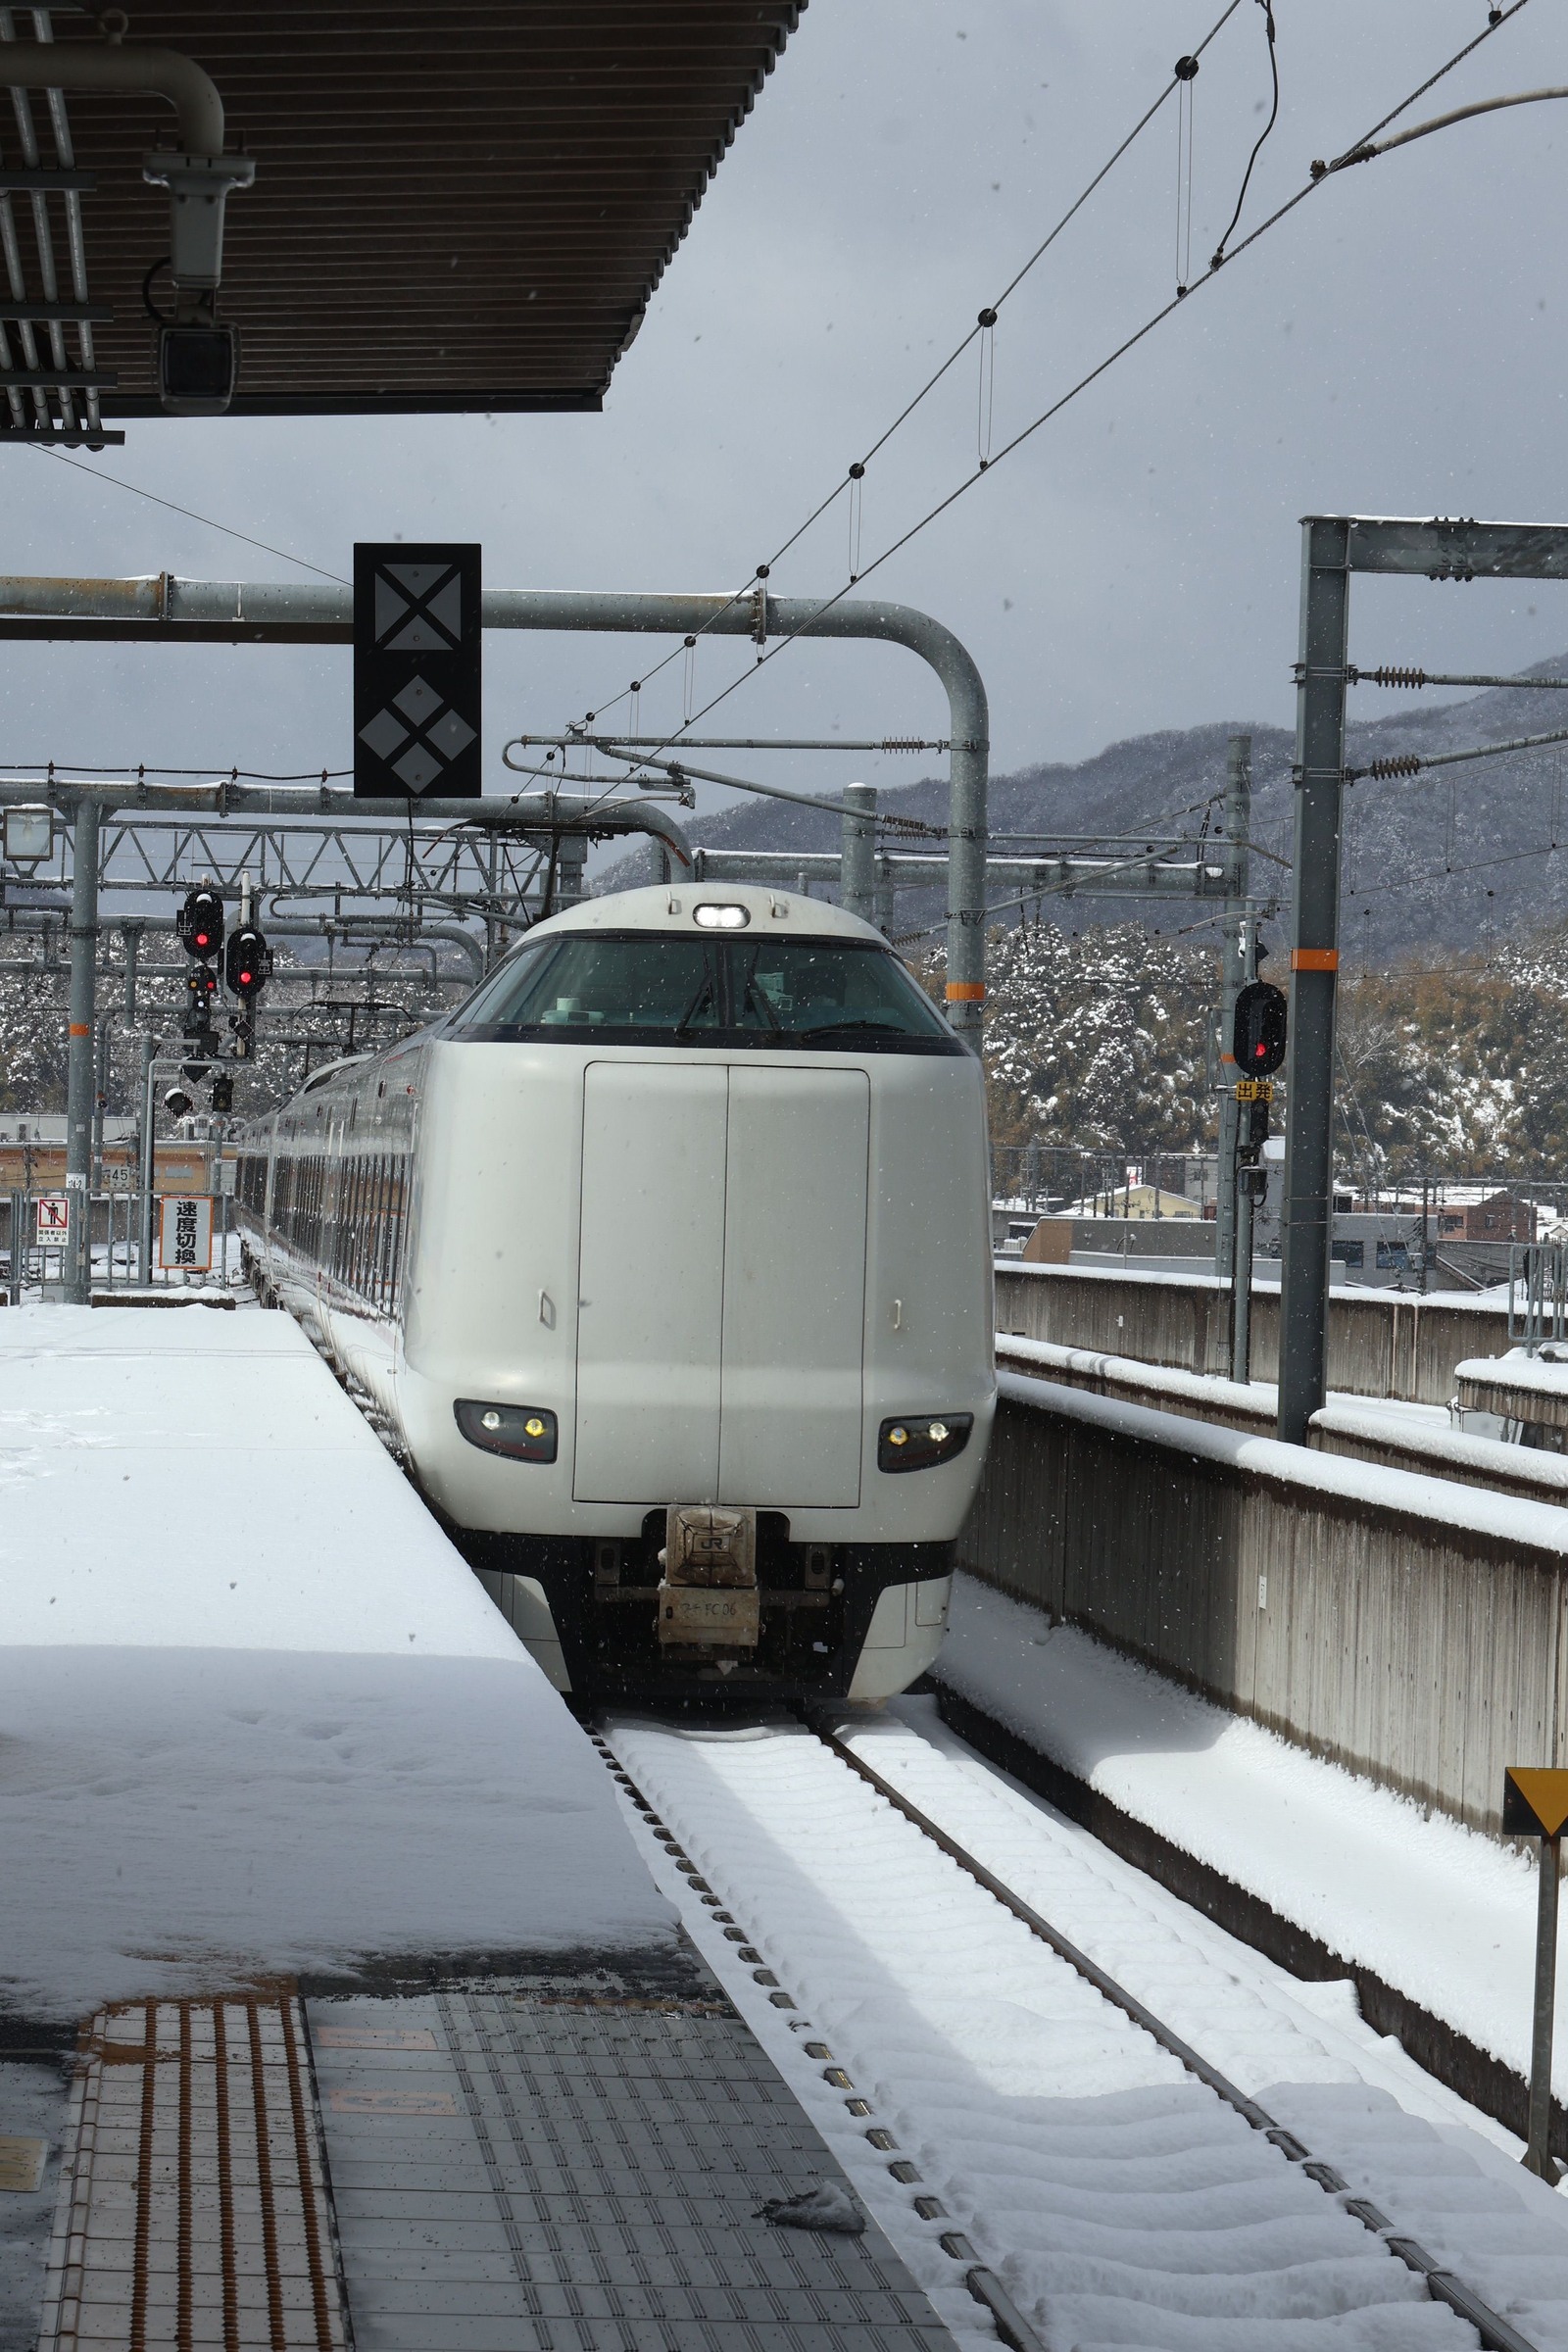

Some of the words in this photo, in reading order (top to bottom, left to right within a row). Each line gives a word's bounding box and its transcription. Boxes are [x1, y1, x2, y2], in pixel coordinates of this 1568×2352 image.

[1238, 1083, 1271, 1099] 出発
[112, 1169, 128, 1181] 45
[175, 1200, 198, 1264] 速度切換
[701, 1537, 723, 1550] JR
